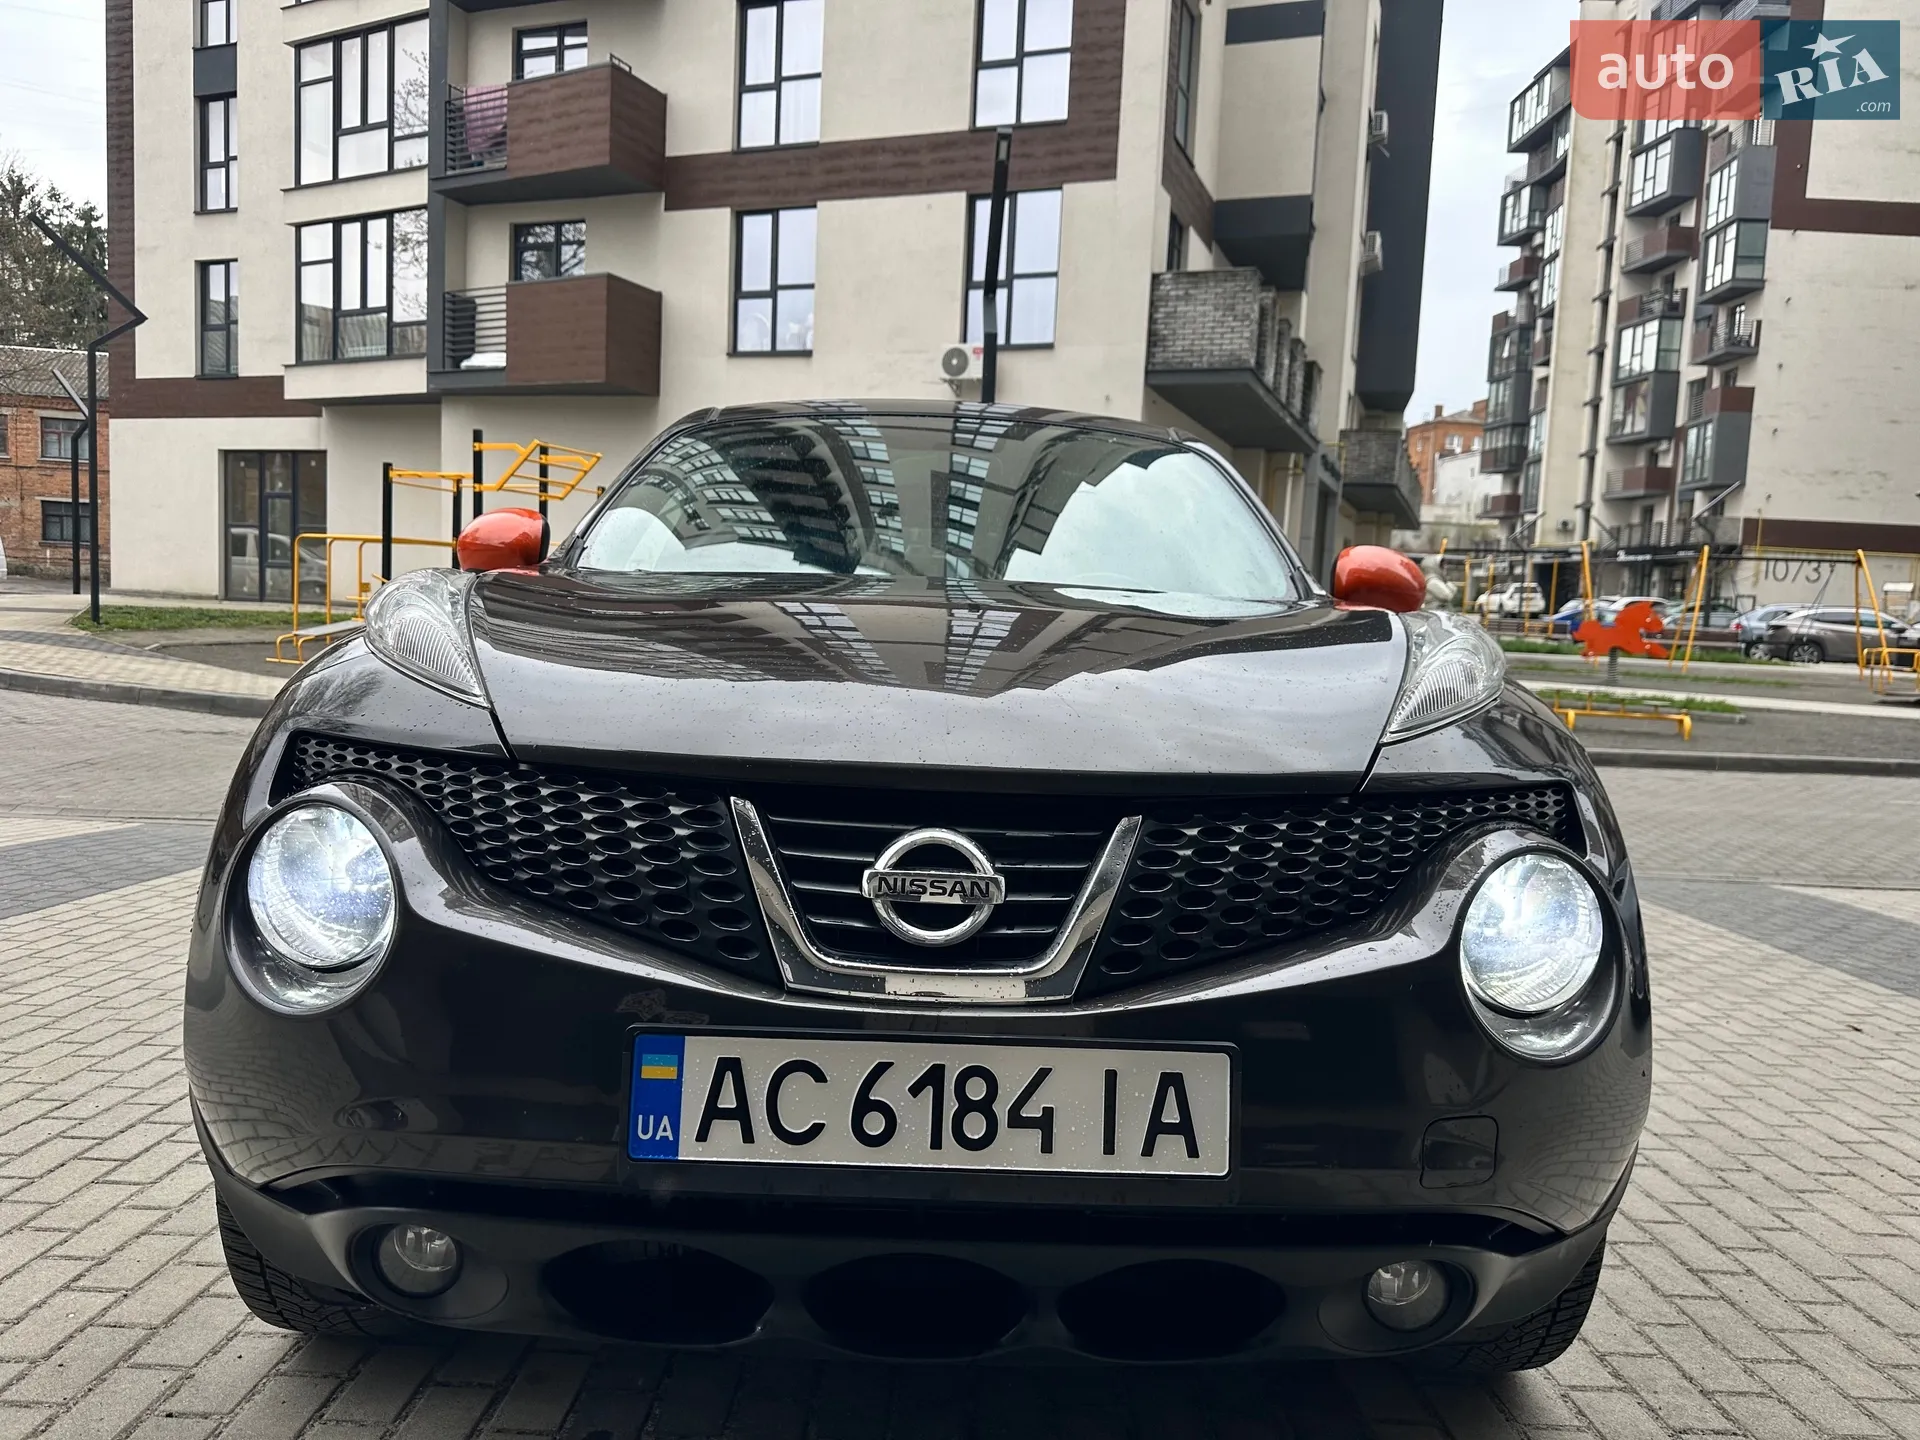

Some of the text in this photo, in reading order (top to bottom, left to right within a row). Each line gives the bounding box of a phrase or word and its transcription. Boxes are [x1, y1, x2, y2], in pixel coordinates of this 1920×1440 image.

[877, 876, 990, 898] NISSAN
[694, 1056, 1200, 1158] AC 6184 IA
[637, 1115, 674, 1142] UA
